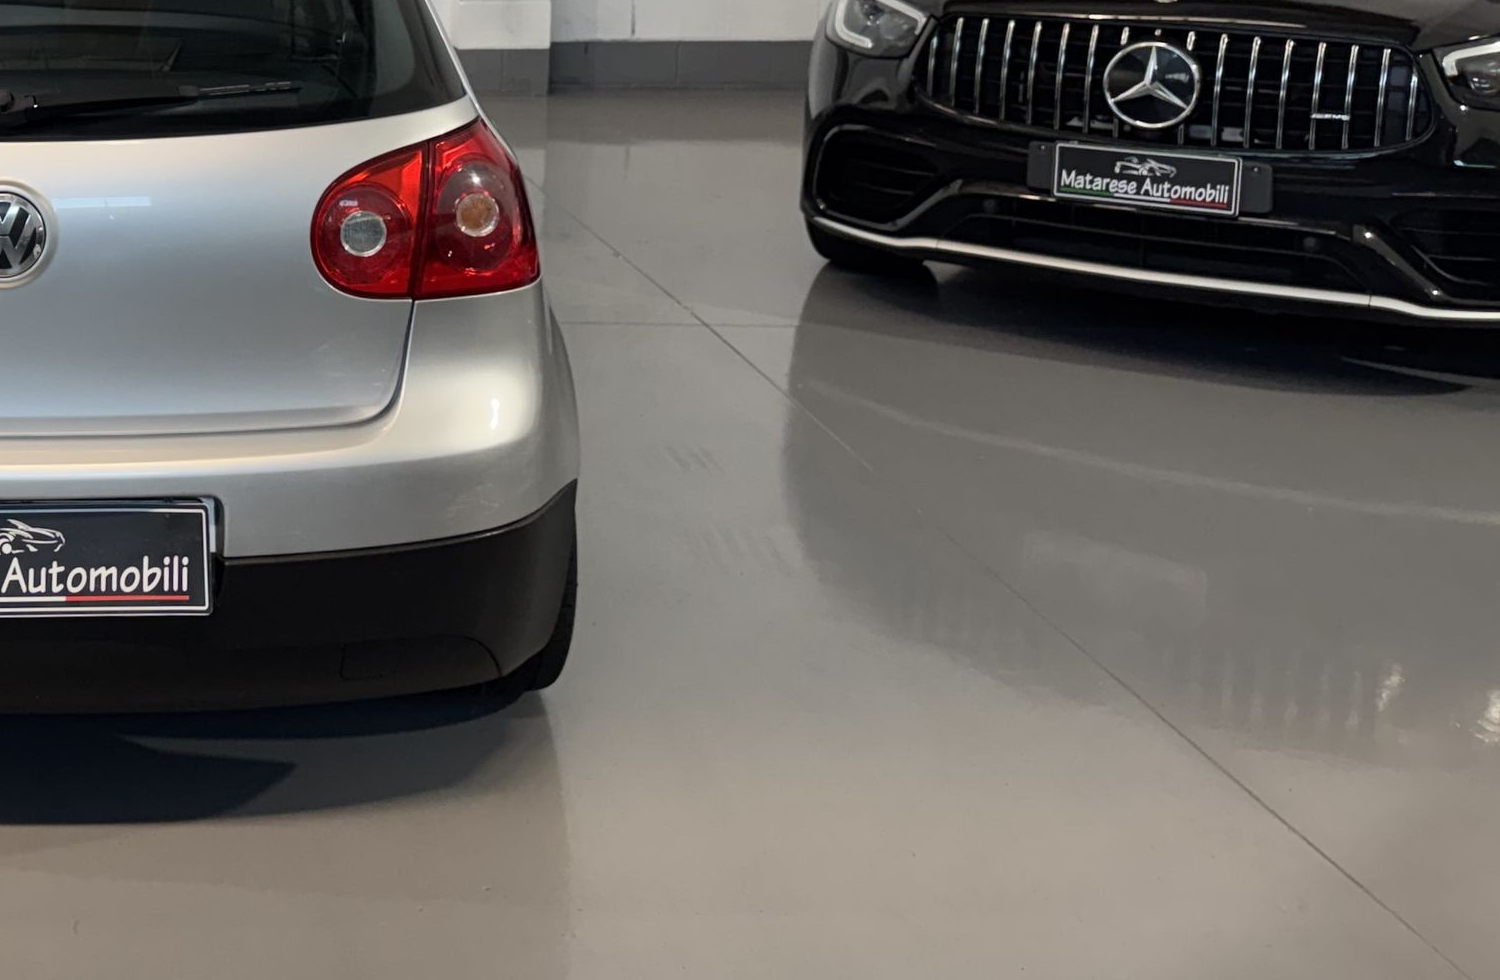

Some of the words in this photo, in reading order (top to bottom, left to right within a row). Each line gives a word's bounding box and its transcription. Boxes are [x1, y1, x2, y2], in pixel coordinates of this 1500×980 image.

[1060, 169, 1137, 195] Matarese
[1140, 177, 1229, 204] Automobili
[0, 555, 190, 595] Automobili
